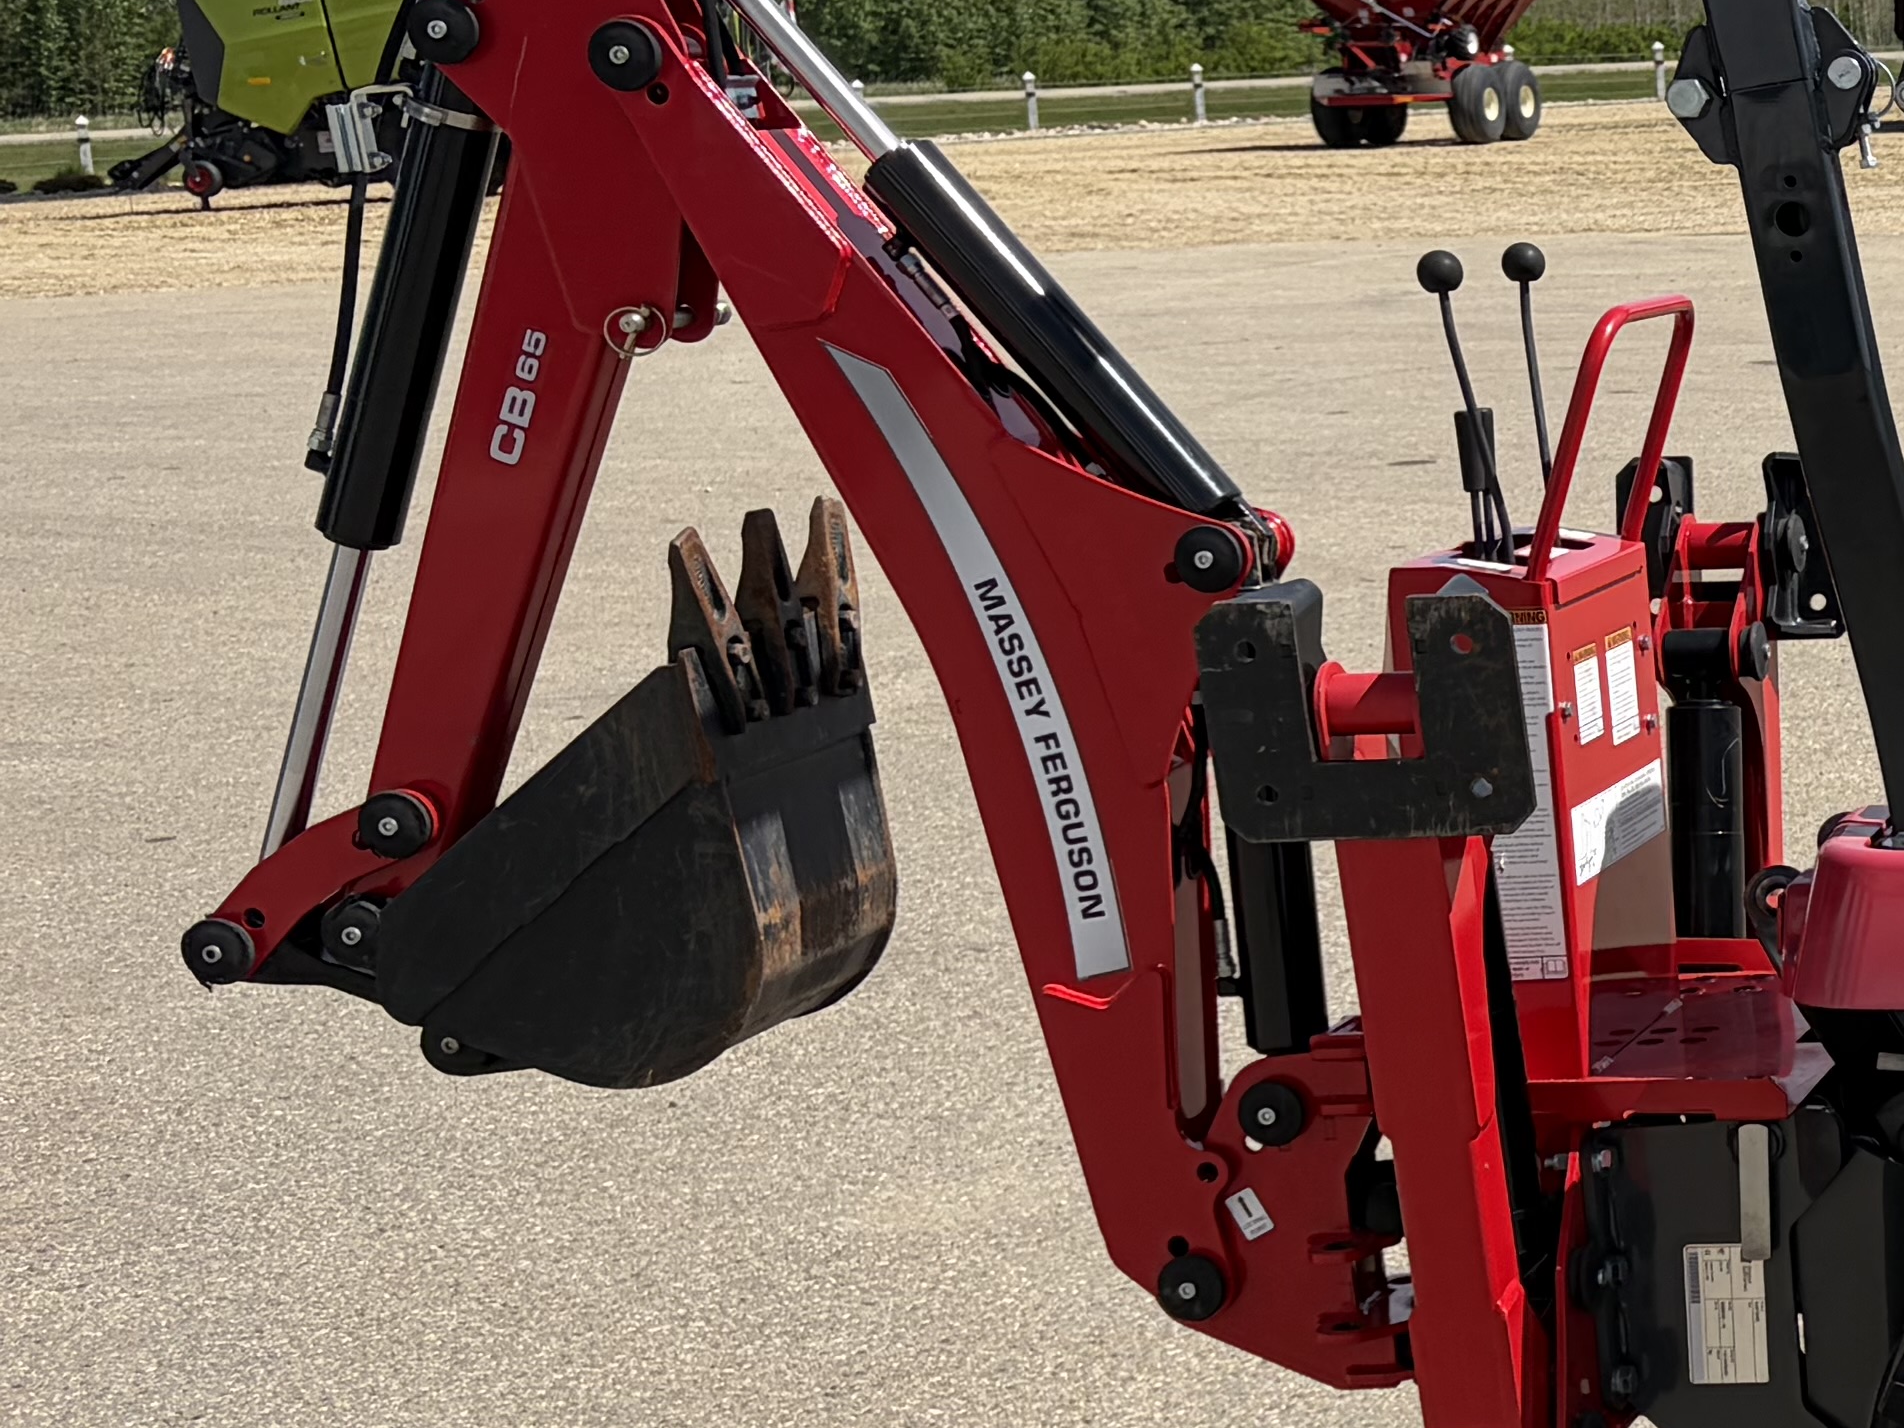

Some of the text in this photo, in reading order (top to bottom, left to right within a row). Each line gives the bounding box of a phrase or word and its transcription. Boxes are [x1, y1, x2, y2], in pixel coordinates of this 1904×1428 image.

[490, 329, 547, 465] CB 65
[1511, 611, 1545, 623] RNING
[974, 577, 1106, 920] MASSEY FERGUSON
